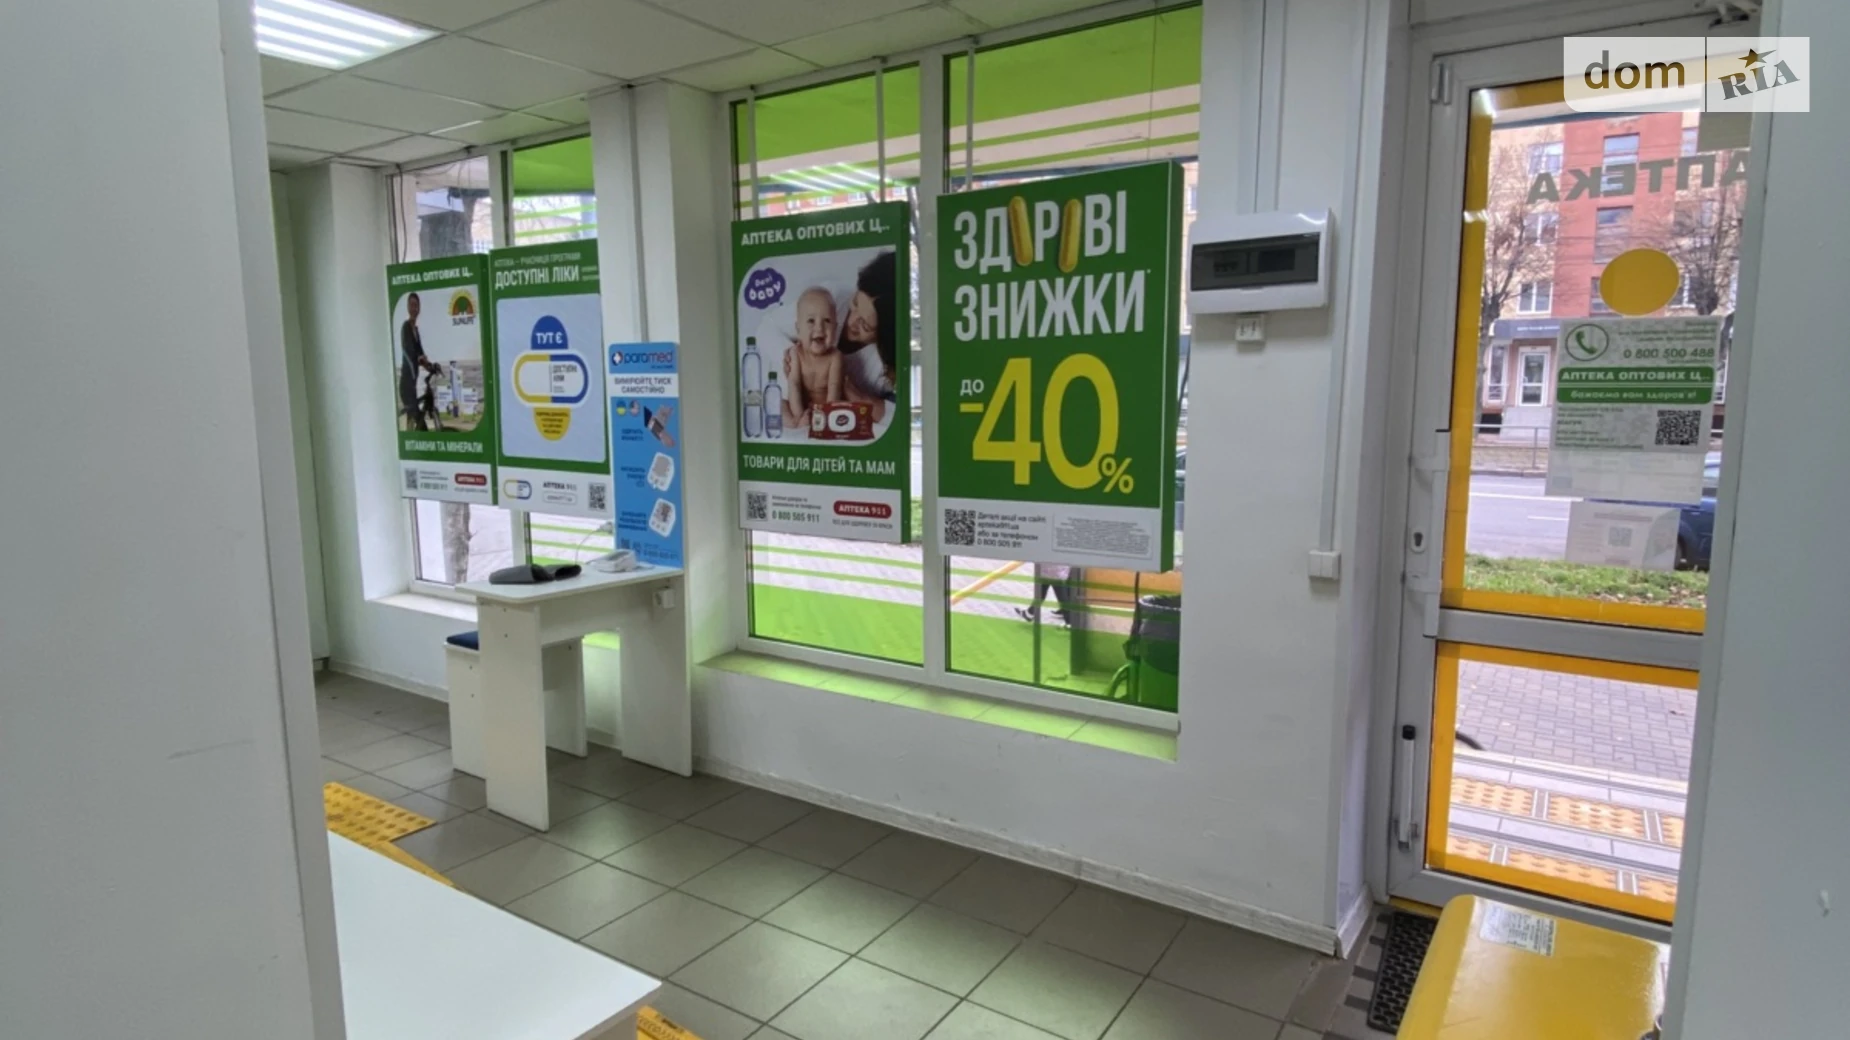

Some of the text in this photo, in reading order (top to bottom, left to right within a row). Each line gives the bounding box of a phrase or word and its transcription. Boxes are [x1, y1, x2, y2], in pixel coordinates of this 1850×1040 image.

[741, 229, 793, 247] АПТЕКА
[796, 220, 865, 241] ОПТОВИХ
[391, 273, 422, 286] АПТЕКА
[423, 269, 461, 282] ОПТОВИХ
[494, 265, 580, 290] ДОСТУПНІ ЛІКИ
[535, 331, 564, 345] ТУТ Є
[1623, 349, 1632, 359] 0
[1635, 348, 1659, 359] 800
[1662, 348, 1688, 359] 500
[1561, 371, 1615, 381] АПТЕКА
[1618, 371, 1686, 381] ОПТОВИХ
[437, 441, 447, 452] ТА
[742, 454, 895, 476] ТОВАРИ ДЛЯ ДІТЕЙ ТА МАМ
[772, 510, 820, 523] 0 800 505 911
[838, 504, 887, 516] АПТЕКА 911
